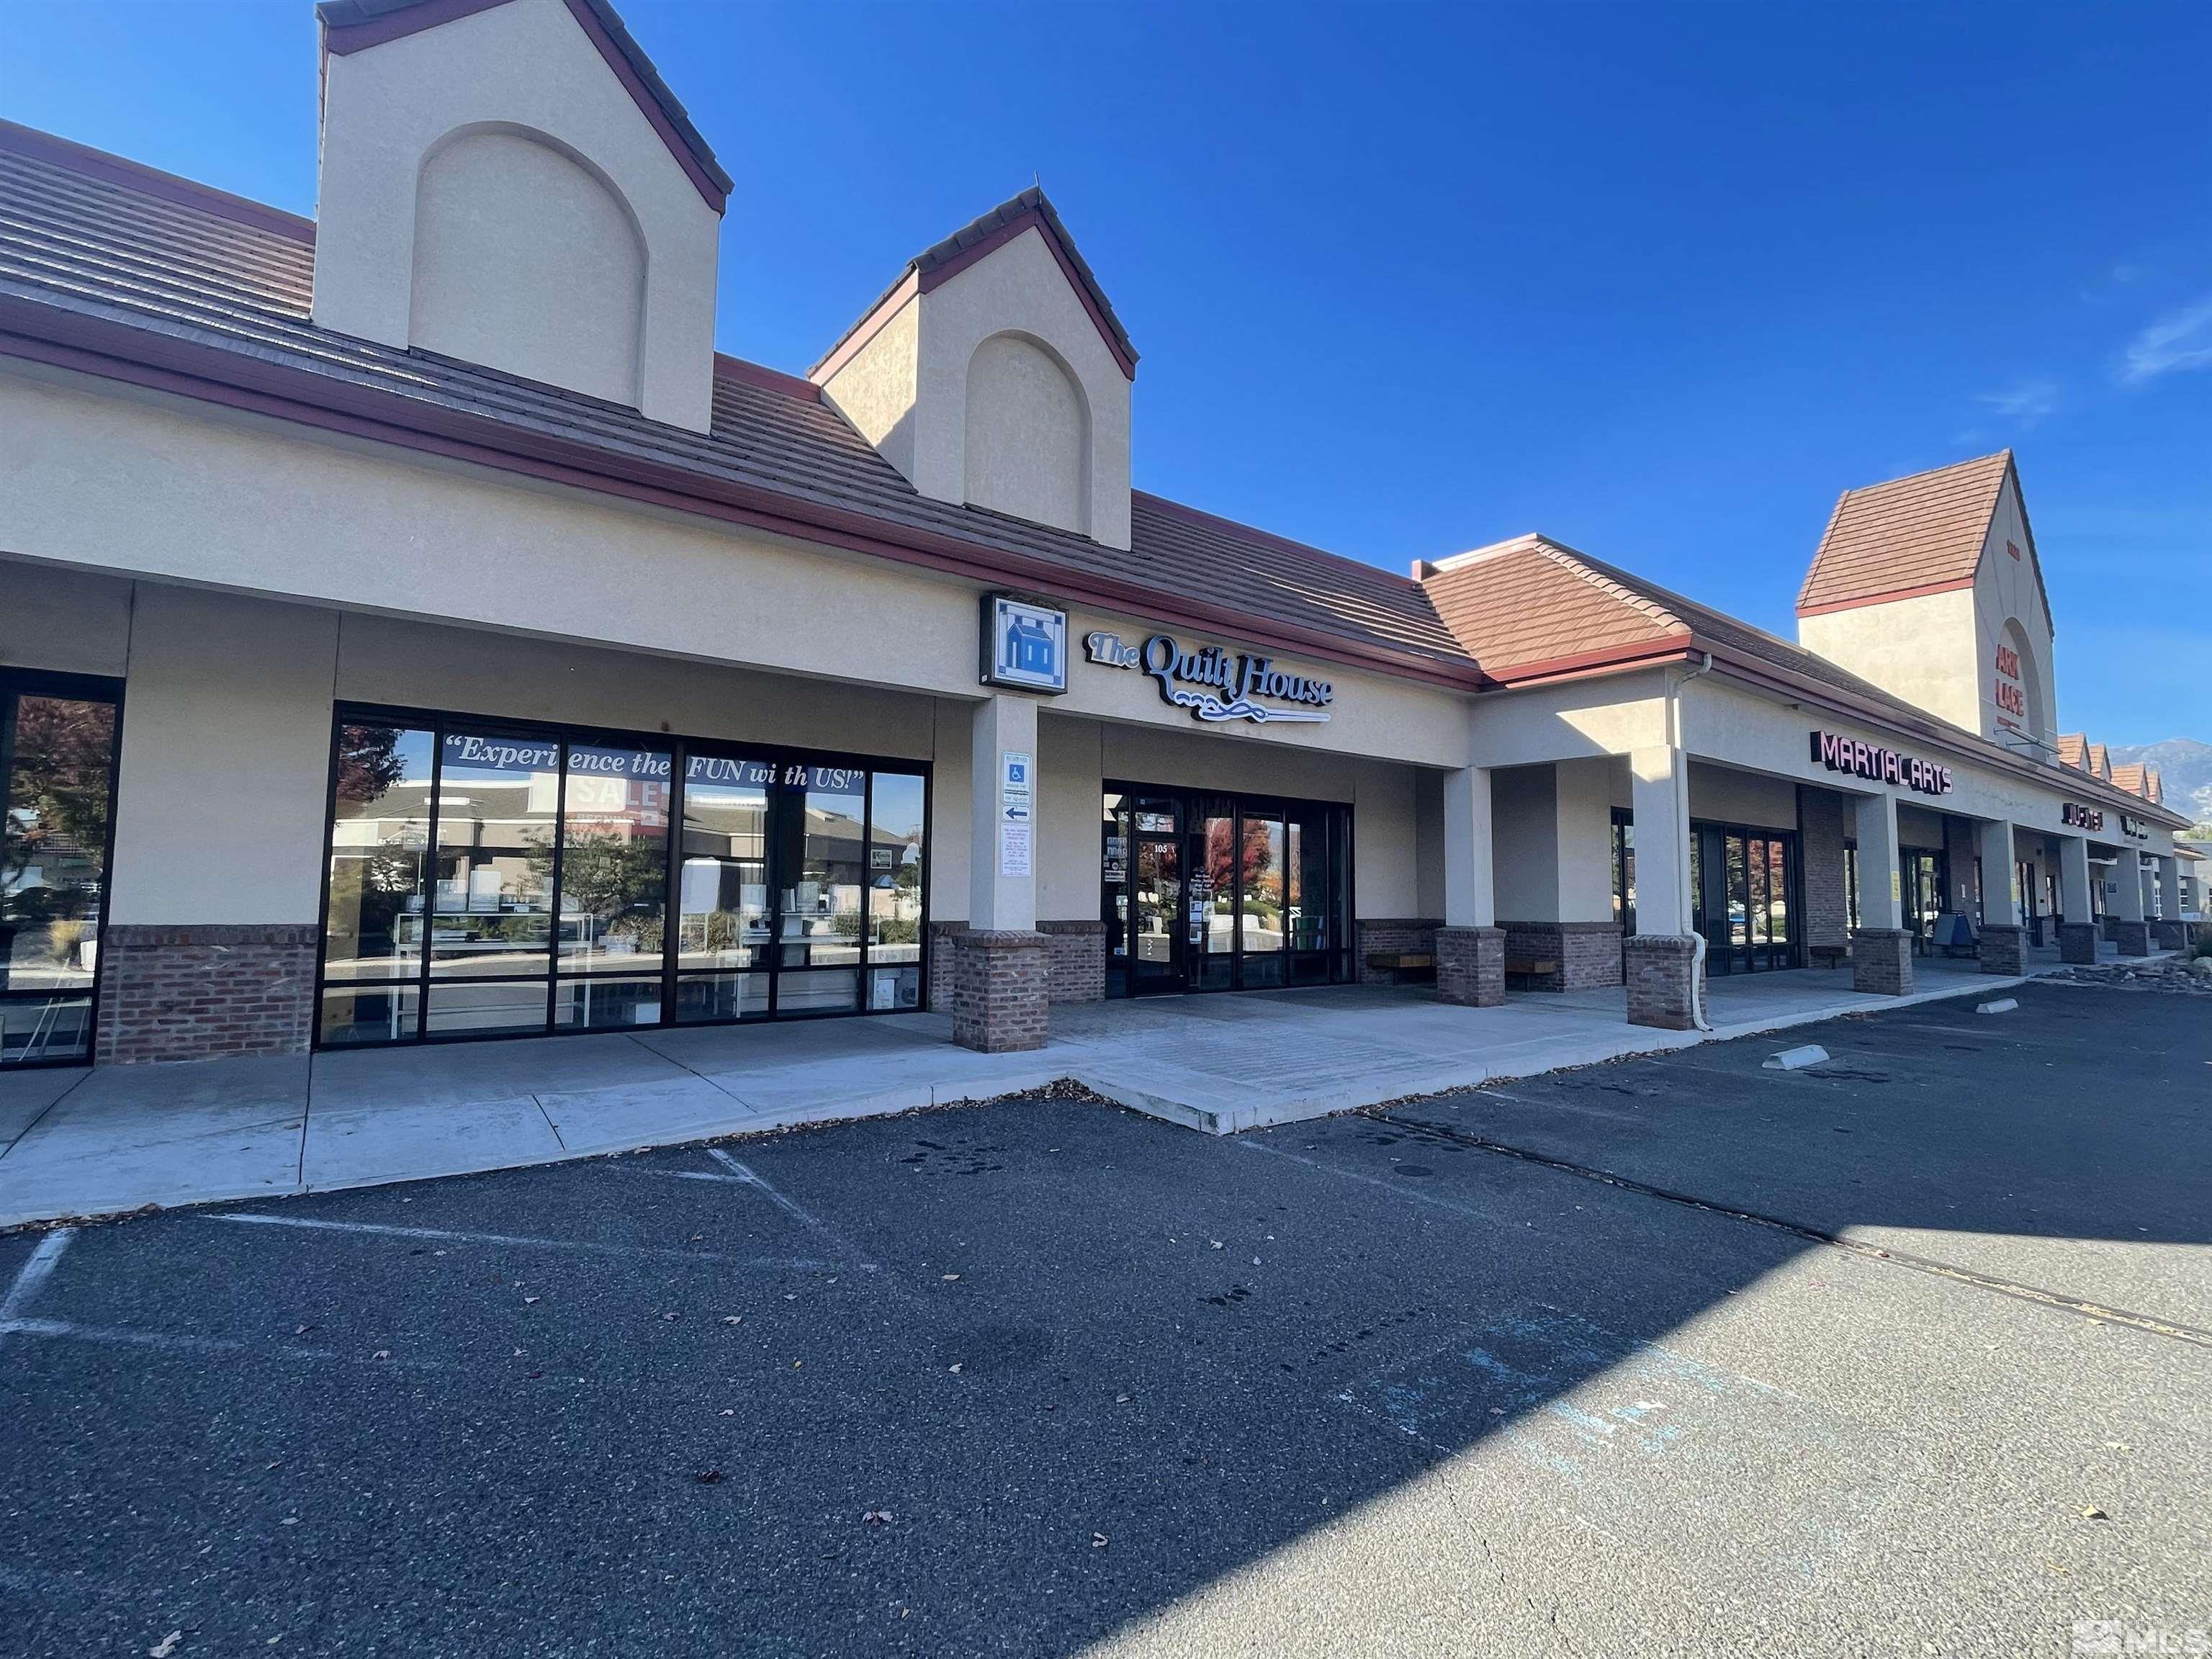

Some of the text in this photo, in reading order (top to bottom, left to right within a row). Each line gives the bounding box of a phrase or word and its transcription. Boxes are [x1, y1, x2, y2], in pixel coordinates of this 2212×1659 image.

[1091, 633, 1334, 705] The Quilt House
[631, 752, 671, 775] the
[686, 756, 747, 781] FUN
[1818, 730, 1953, 794] MARTIAL ARTS
[576, 780, 657, 806] SALE
[1154, 845, 1168, 853] 105
